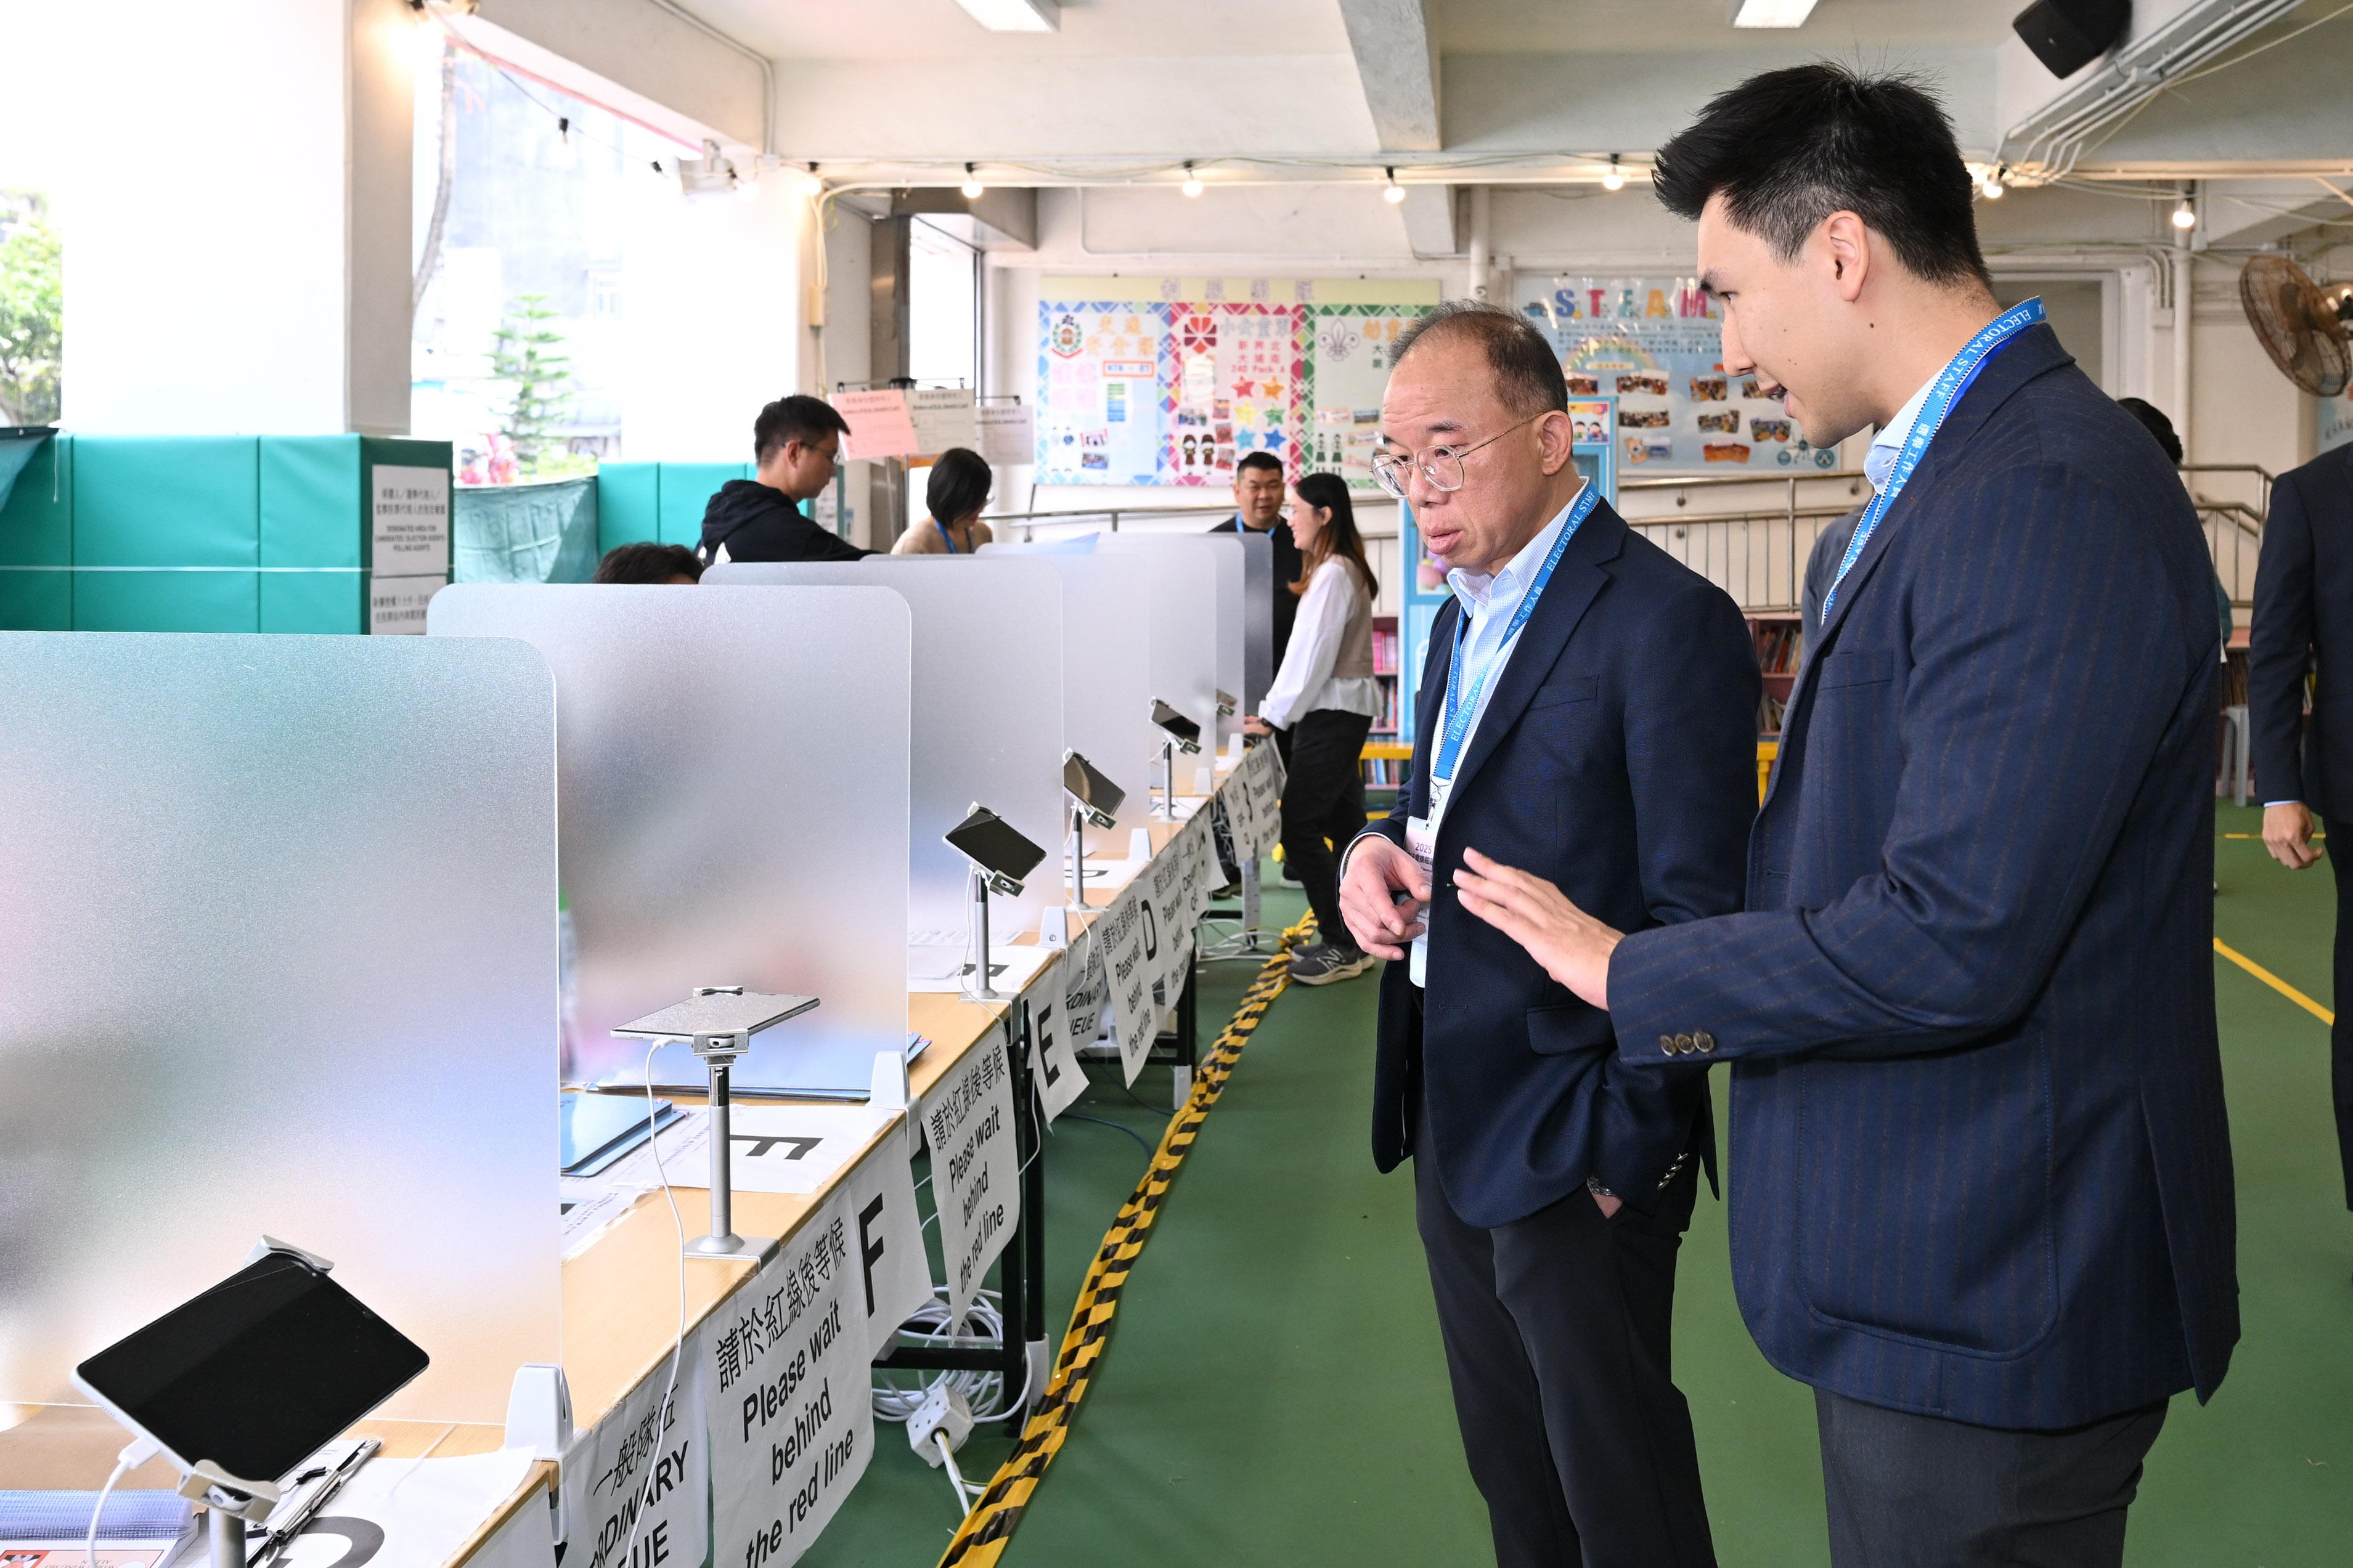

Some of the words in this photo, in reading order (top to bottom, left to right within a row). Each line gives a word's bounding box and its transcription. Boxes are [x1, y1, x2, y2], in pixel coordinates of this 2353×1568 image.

[1555, 288, 1707, 317] STEAM
[1965, 309, 2032, 354] ELECTORAL
[1936, 358, 1968, 400] STAFF
[1546, 513, 1582, 572] ELECTORAL
[1578, 490, 1595, 513] STAFF
[1450, 681, 1481, 742] ELECTORAL
[1415, 842, 1432, 854] 2025
[1141, 899, 1157, 962] D
[1037, 1003, 1061, 1089] E
[931, 1044, 1005, 1154] 請於紅線後等候
[949, 1134, 974, 1193] Please
[976, 1106, 1000, 1150] wait
[962, 1161, 989, 1229] behind
[858, 1193, 884, 1318] F
[960, 1253, 972, 1294] the
[971, 1220, 982, 1269] red
[983, 1203, 1004, 1243] line
[716, 1216, 846, 1394] 請於紅線後等候
[743, 1349, 805, 1444] Please
[809, 1296, 842, 1364] wait
[593, 1384, 679, 1497] 一般隊伍
[772, 1376, 832, 1486] behind
[746, 1519, 782, 1568] the
[789, 1461, 818, 1534] red
[825, 1429, 854, 1489] line
